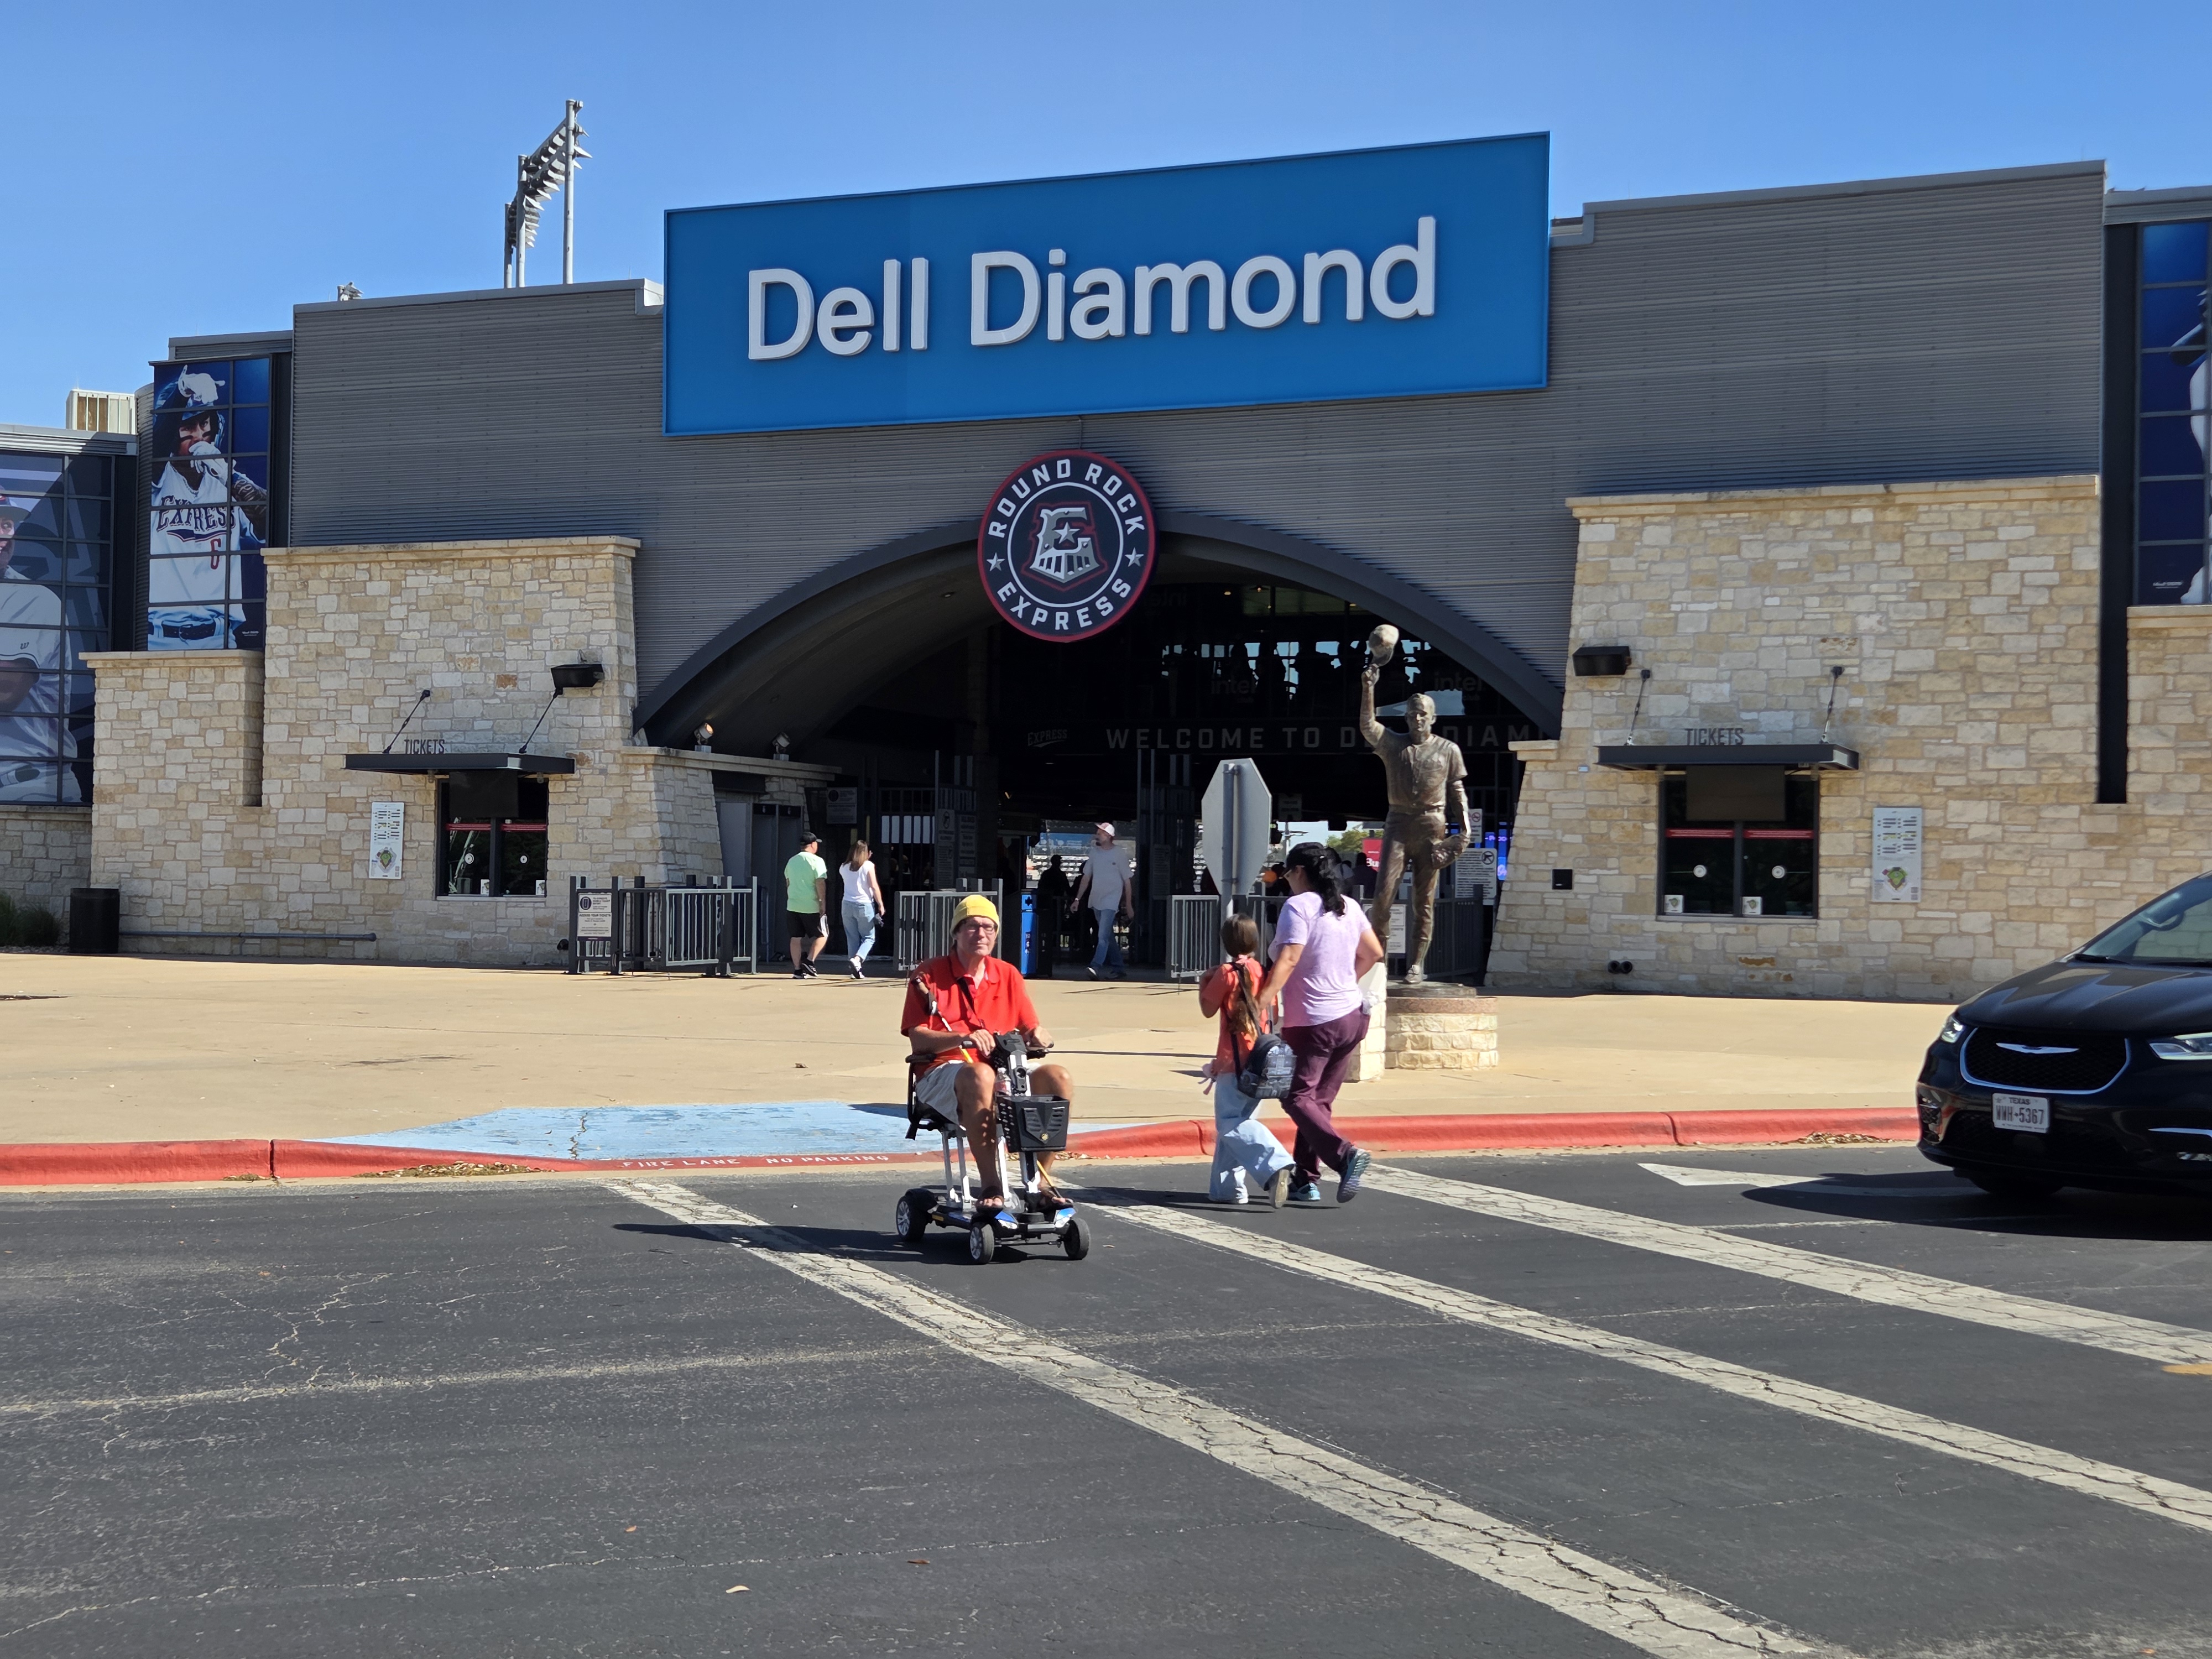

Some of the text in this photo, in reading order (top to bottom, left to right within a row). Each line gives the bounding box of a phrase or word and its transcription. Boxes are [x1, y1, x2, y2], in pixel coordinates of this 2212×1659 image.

[748, 216, 1436, 361] Dell Diamond
[988, 458, 1145, 538] ROUND ROCK
[210, 538, 221, 570] 6
[997, 578, 1131, 630] EXPRESS
[1434, 671, 1483, 691] intel
[404, 739, 445, 754] TICKETS
[1027, 729, 1068, 747] EXPRESS
[1106, 728, 1264, 749] WELCOME
[1282, 727, 1319, 748] TO
[1684, 728, 1744, 745] TICKETS
